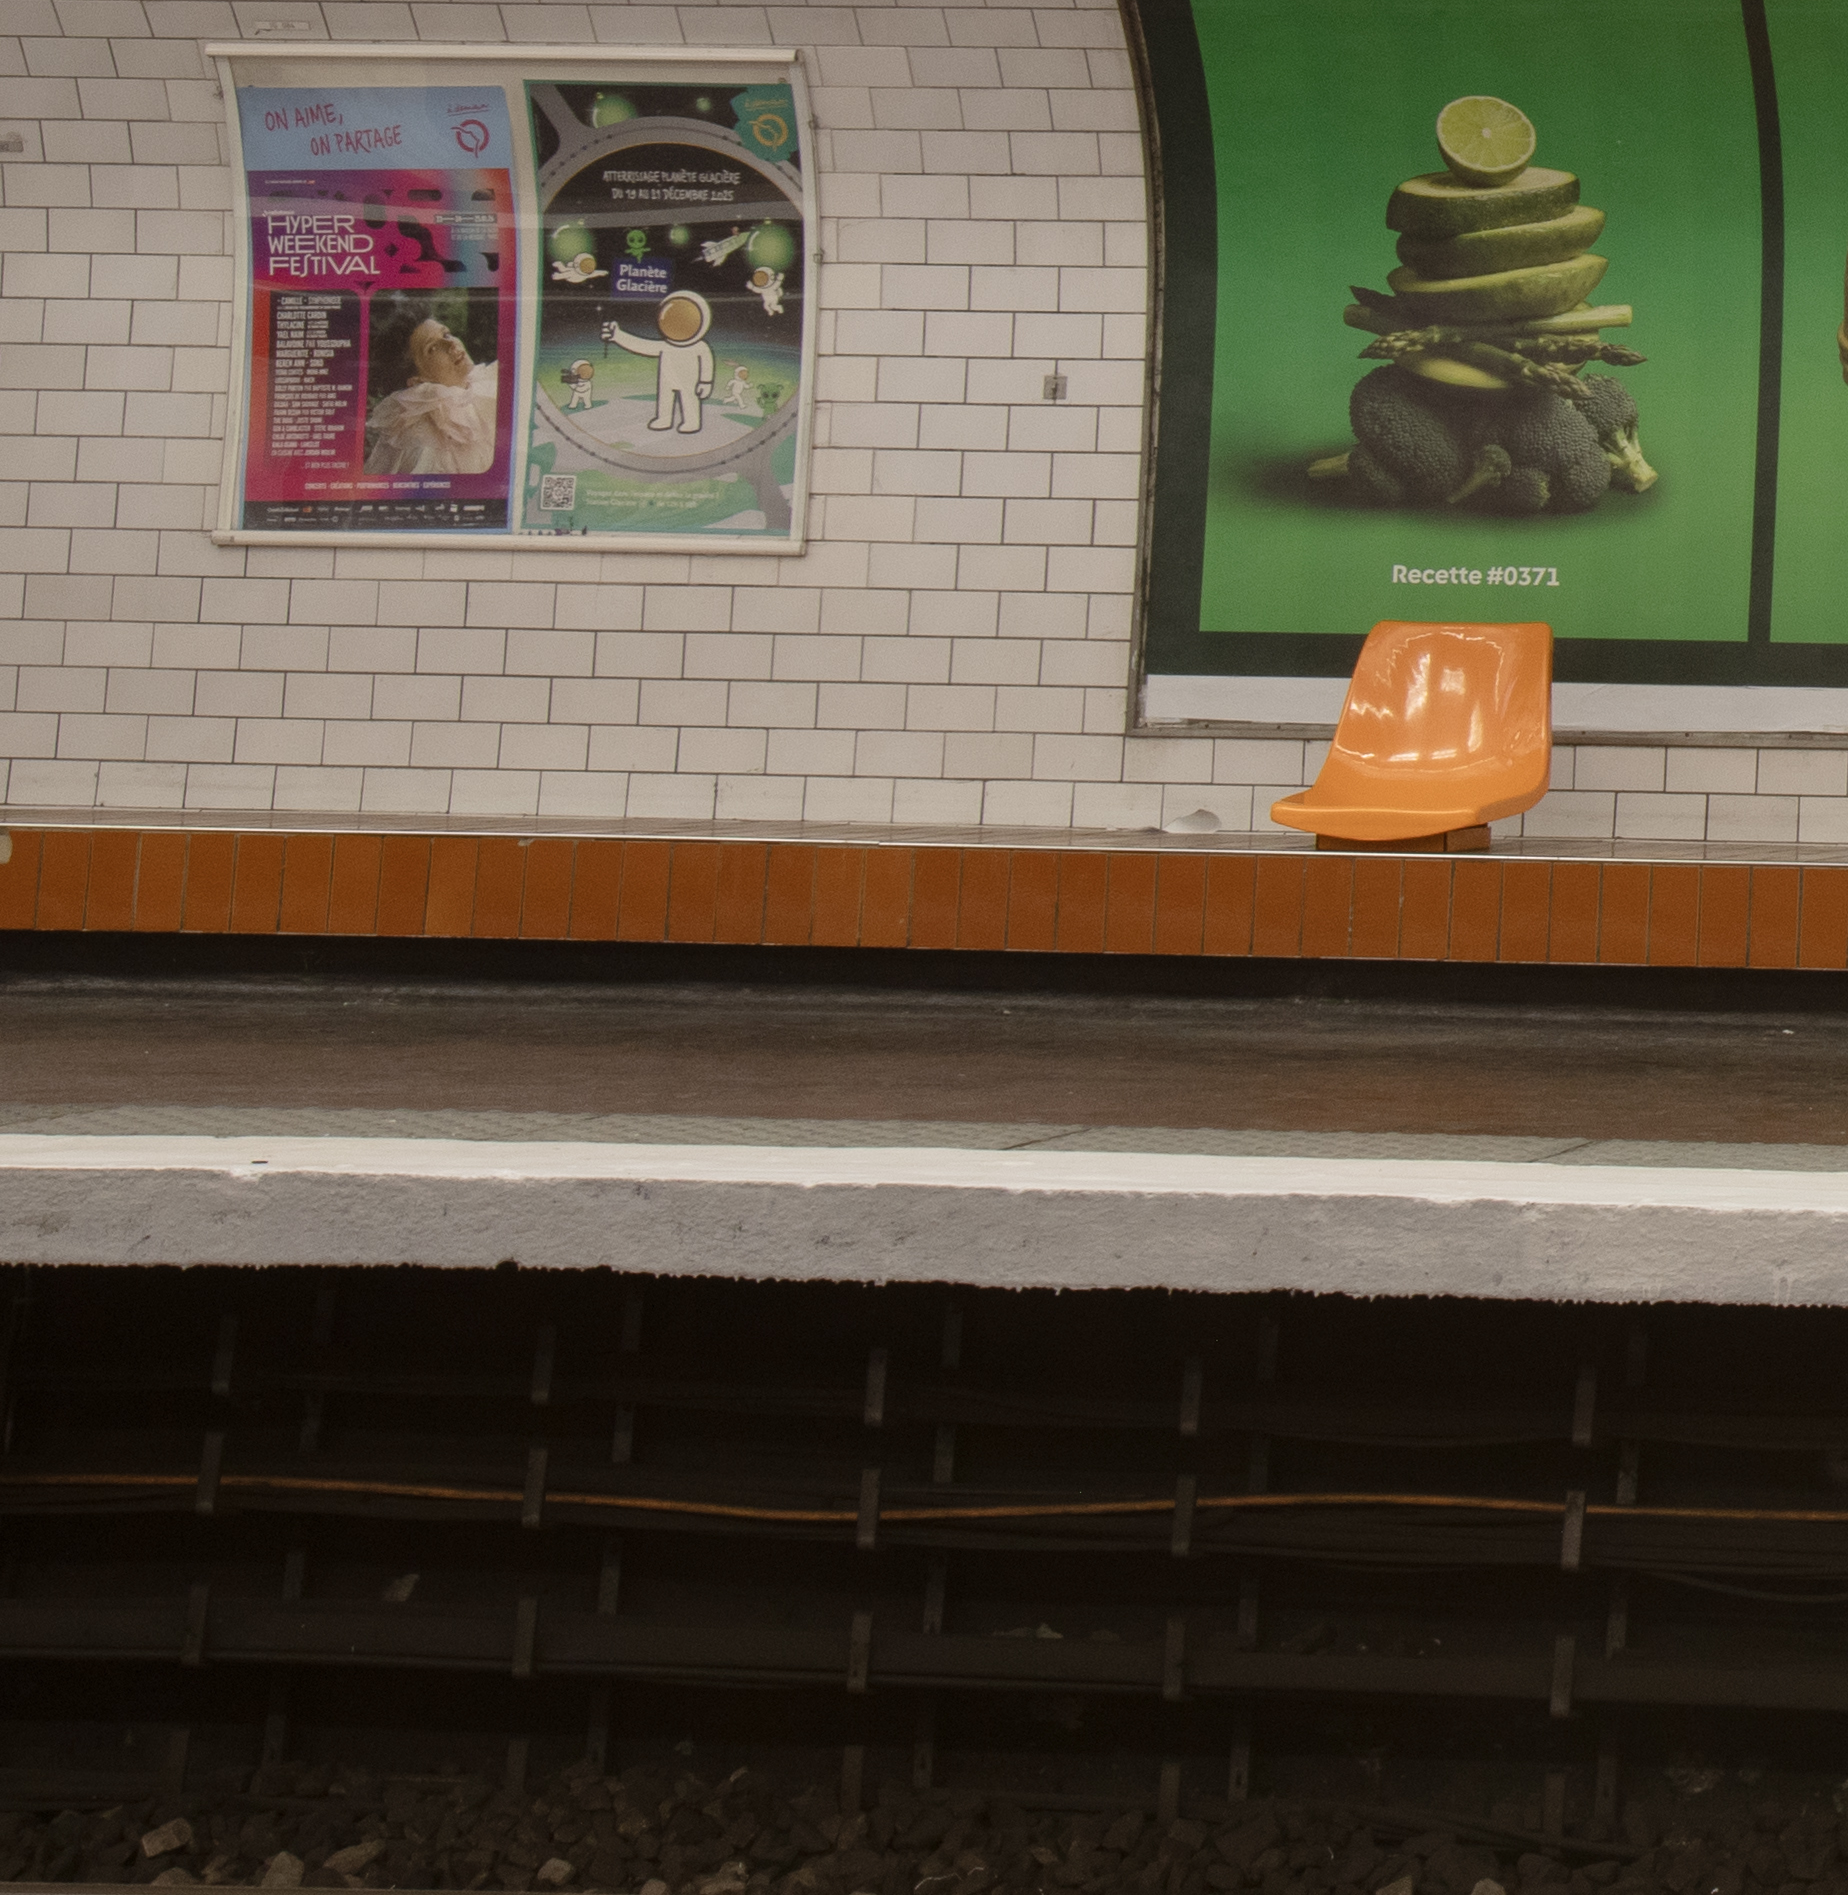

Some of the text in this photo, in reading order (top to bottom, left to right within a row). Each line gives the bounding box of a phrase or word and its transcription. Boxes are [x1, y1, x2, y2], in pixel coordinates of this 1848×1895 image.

[265, 104, 344, 131] ON AIME,
[311, 125, 403, 156] ON PARTAGE
[268, 214, 355, 234] HYPER
[268, 234, 374, 254] WEEKEND
[269, 254, 381, 278] FESTIVAL
[620, 263, 667, 279] Planète
[616, 279, 668, 294] Glacière
[1392, 564, 1560, 586] Recette #0371
